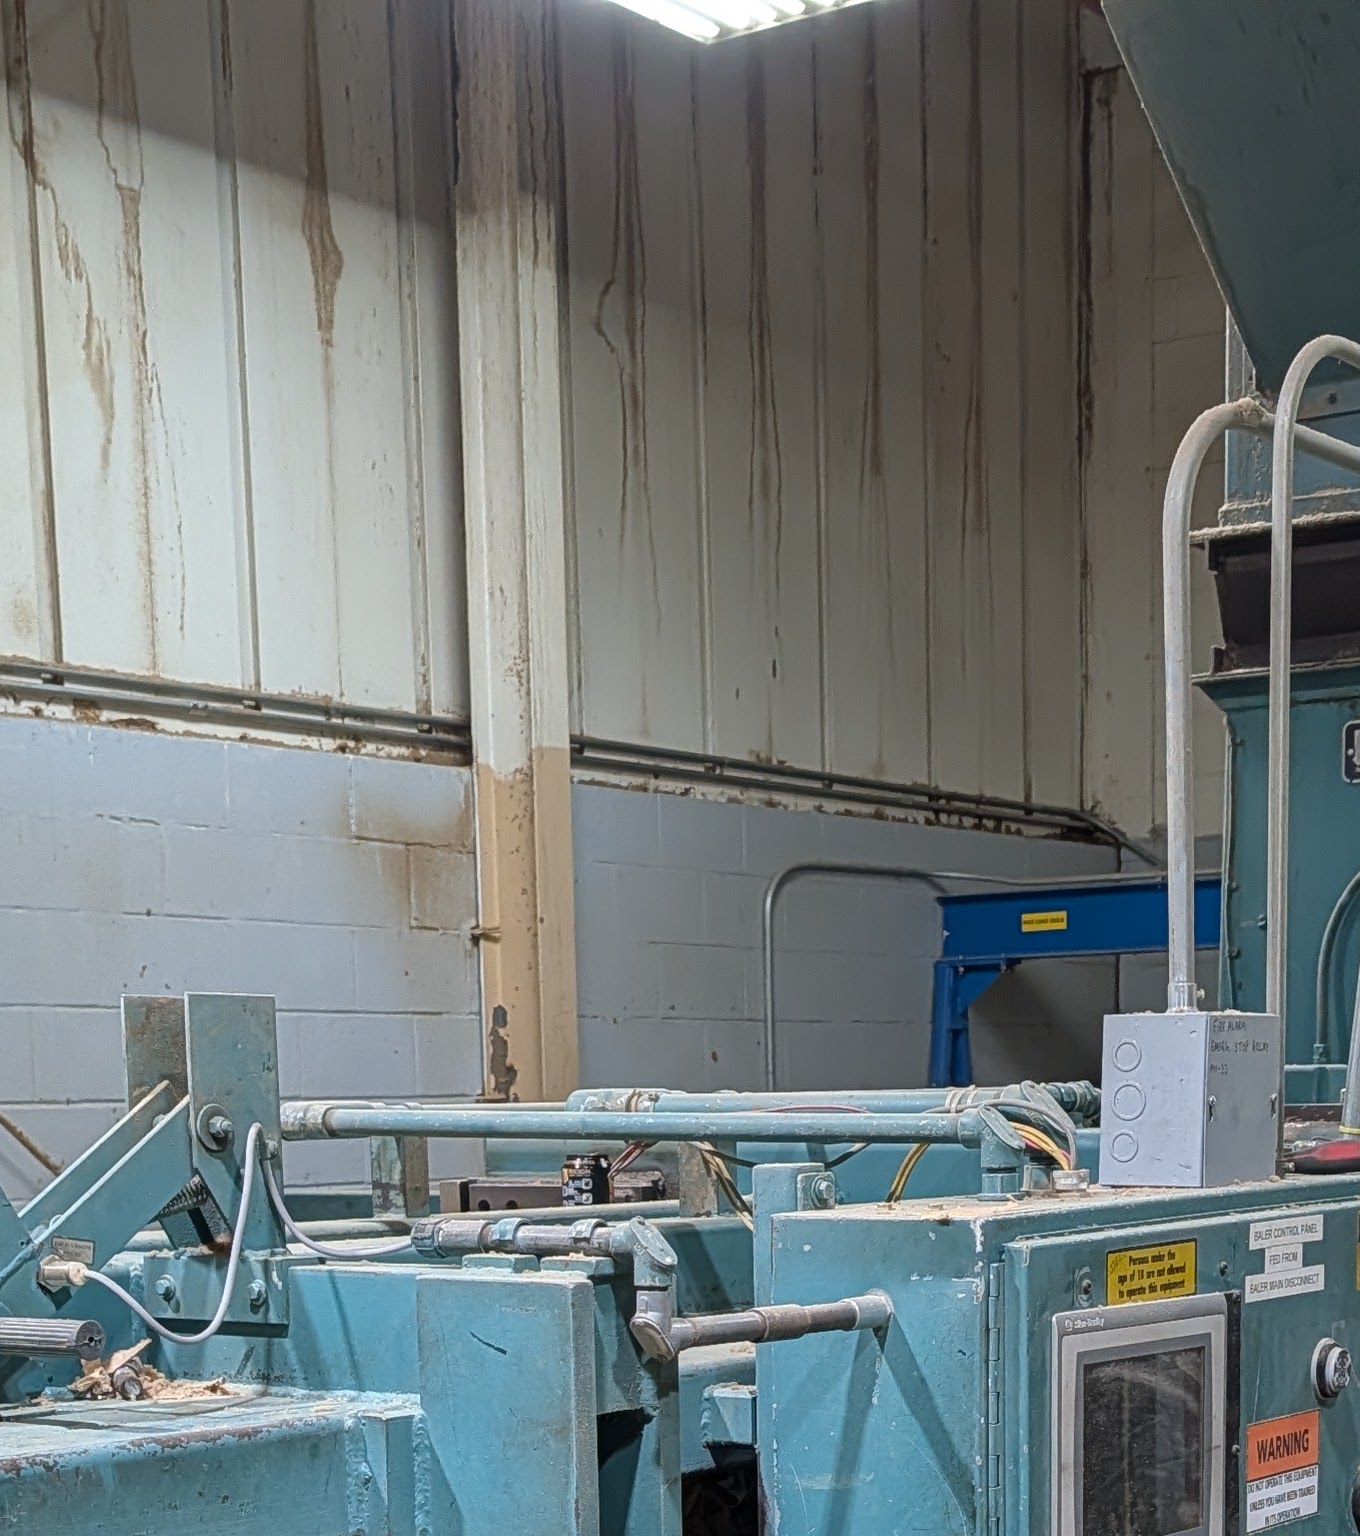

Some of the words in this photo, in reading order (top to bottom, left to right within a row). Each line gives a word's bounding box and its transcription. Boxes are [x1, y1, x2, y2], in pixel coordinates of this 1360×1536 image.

[1253, 1229, 1272, 1241] BALER
[1273, 1225, 1299, 1239] CONTROL
[1301, 1223, 1318, 1234] PANEL
[1129, 1254, 1149, 1267] Persons
[1151, 1250, 1165, 1263] under
[1167, 1249, 1176, 1261] the
[1269, 1254, 1280, 1265] FED
[1282, 1252, 1298, 1263] FROM
[1118, 1274, 1127, 1286] age
[1130, 1270, 1135, 1282] of
[1138, 1269, 1144, 1280] 18
[1146, 1270, 1155, 1279] are
[1157, 1266, 1165, 1278] not
[1167, 1262, 1186, 1276] allowed
[1249, 1281, 1268, 1294] BALER
[1269, 1278, 1283, 1290] MAIN
[1284, 1273, 1319, 1288] DISCONNECT
[1118, 1289, 1124, 1299] to
[1126, 1285, 1146, 1300] operate
[1148, 1281, 1157, 1294] this
[1160, 1279, 1185, 1294] equipment
[1256, 1428, 1309, 1465] WARNING
[1248, 1483, 1254, 1494] DO
[1255, 1480, 1264, 1492] NOT
[1265, 1475, 1283, 1489] OPERATE
[1284, 1472, 1293, 1483] THIS
[1293, 1466, 1317, 1482] EQUIPMENT
[1249, 1498, 1264, 1512] UNLESS
[1265, 1496, 1275, 1508] YOU
[1275, 1492, 1286, 1505] HAVE
[1286, 1489, 1297, 1502] BEEN
[1298, 1485, 1316, 1498] TRAINED
[1265, 1516, 1269, 1526] IN
[1276, 1507, 1300, 1522] OPERATION
